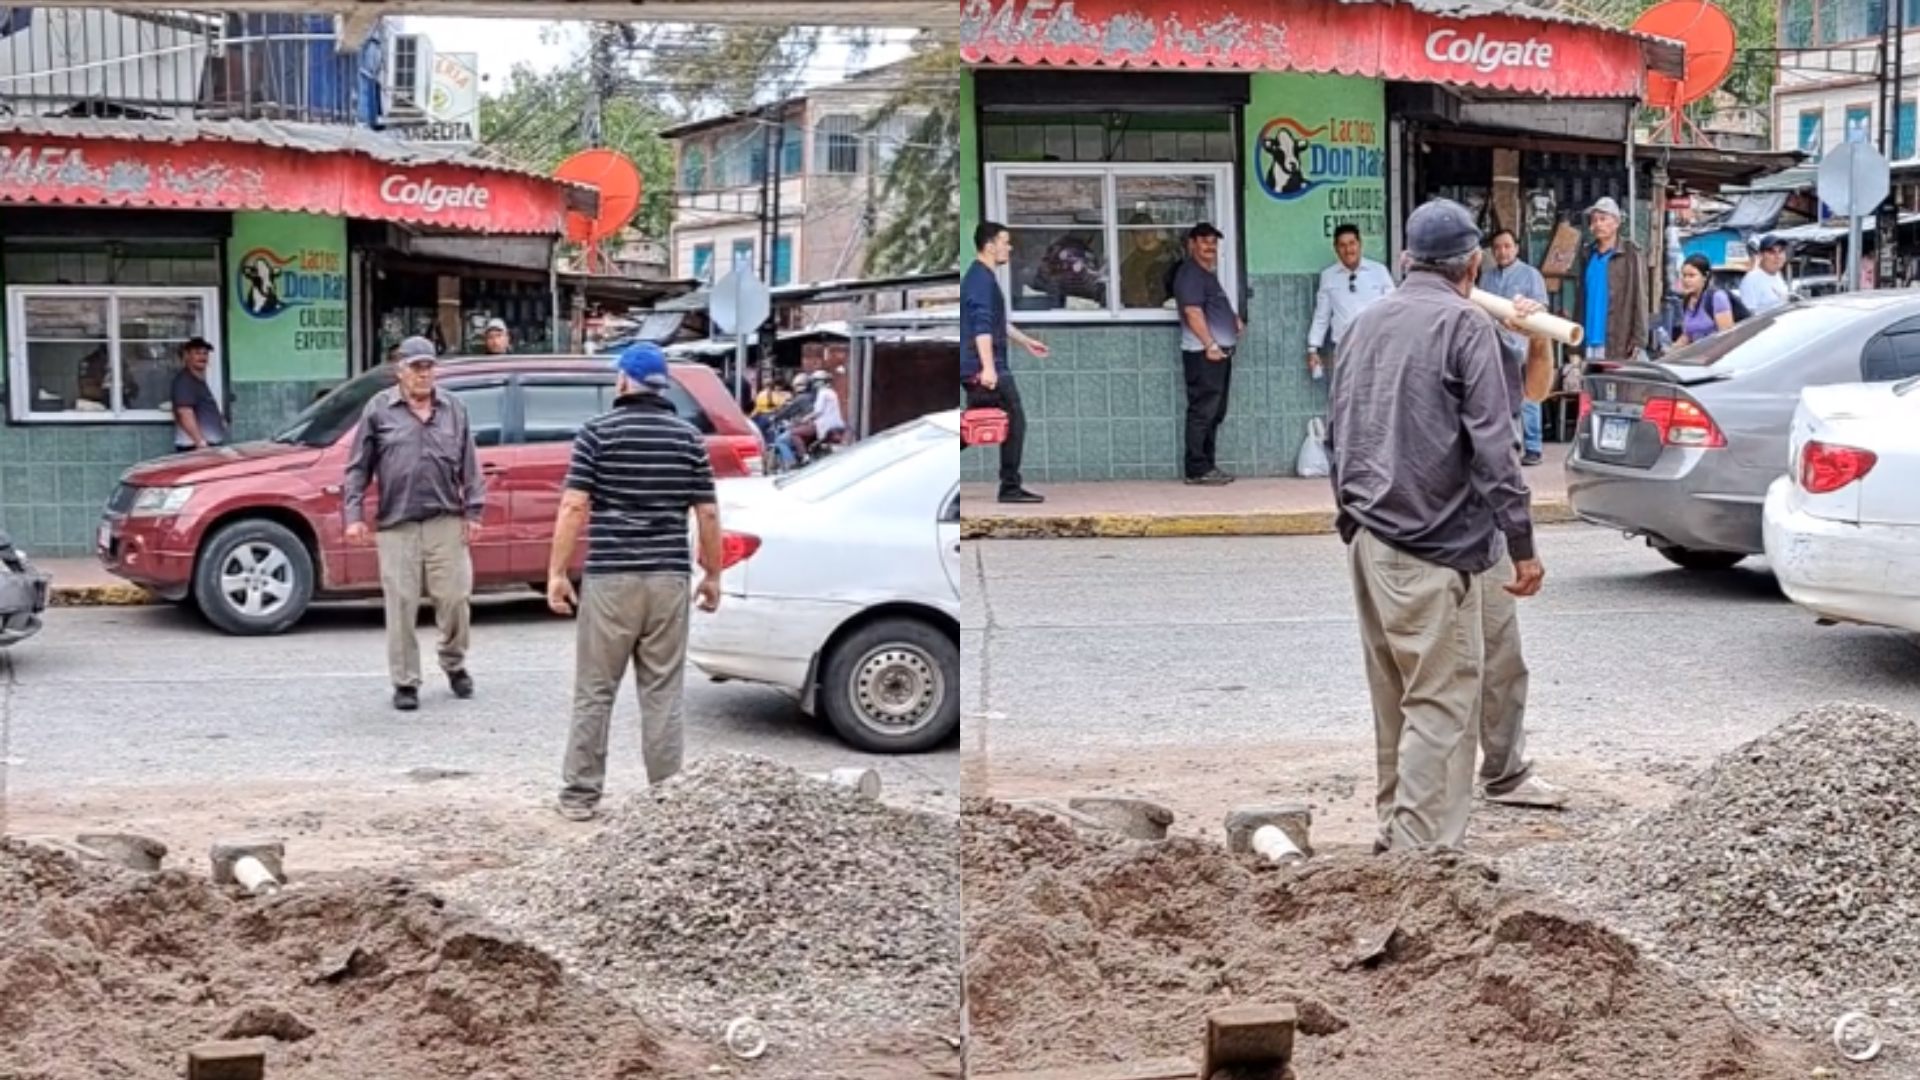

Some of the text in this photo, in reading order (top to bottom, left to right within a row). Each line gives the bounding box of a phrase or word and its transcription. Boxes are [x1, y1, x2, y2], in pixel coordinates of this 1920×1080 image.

[1425, 28, 1553, 73] Colgate
[1310, 144, 1352, 177] Don
[381, 174, 490, 213] Colgate
[283, 270, 320, 299] Don
